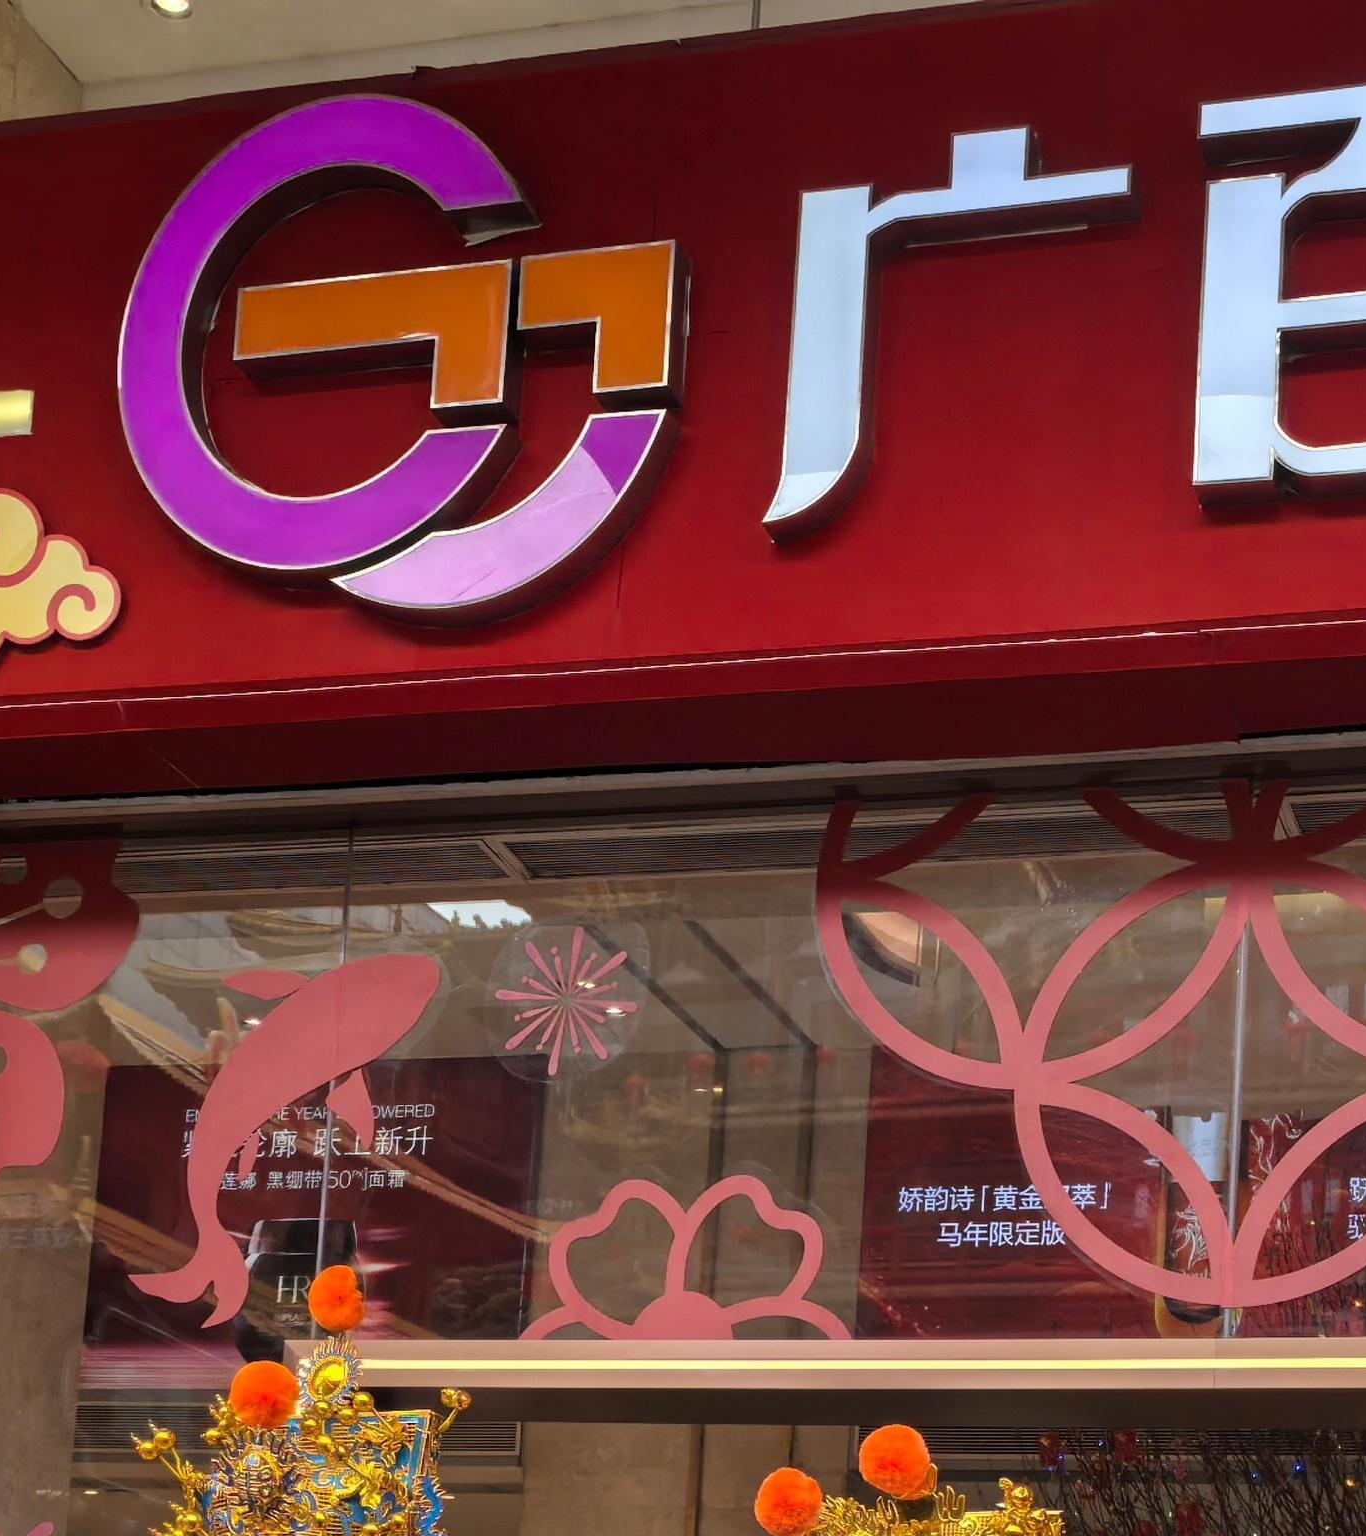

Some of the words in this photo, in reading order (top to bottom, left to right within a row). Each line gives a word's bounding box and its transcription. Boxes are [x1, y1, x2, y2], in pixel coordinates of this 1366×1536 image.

[897, 1181, 1113, 1214] 娇韵诗「黄金萃」
[936, 1220, 1066, 1249] 马年限定版
